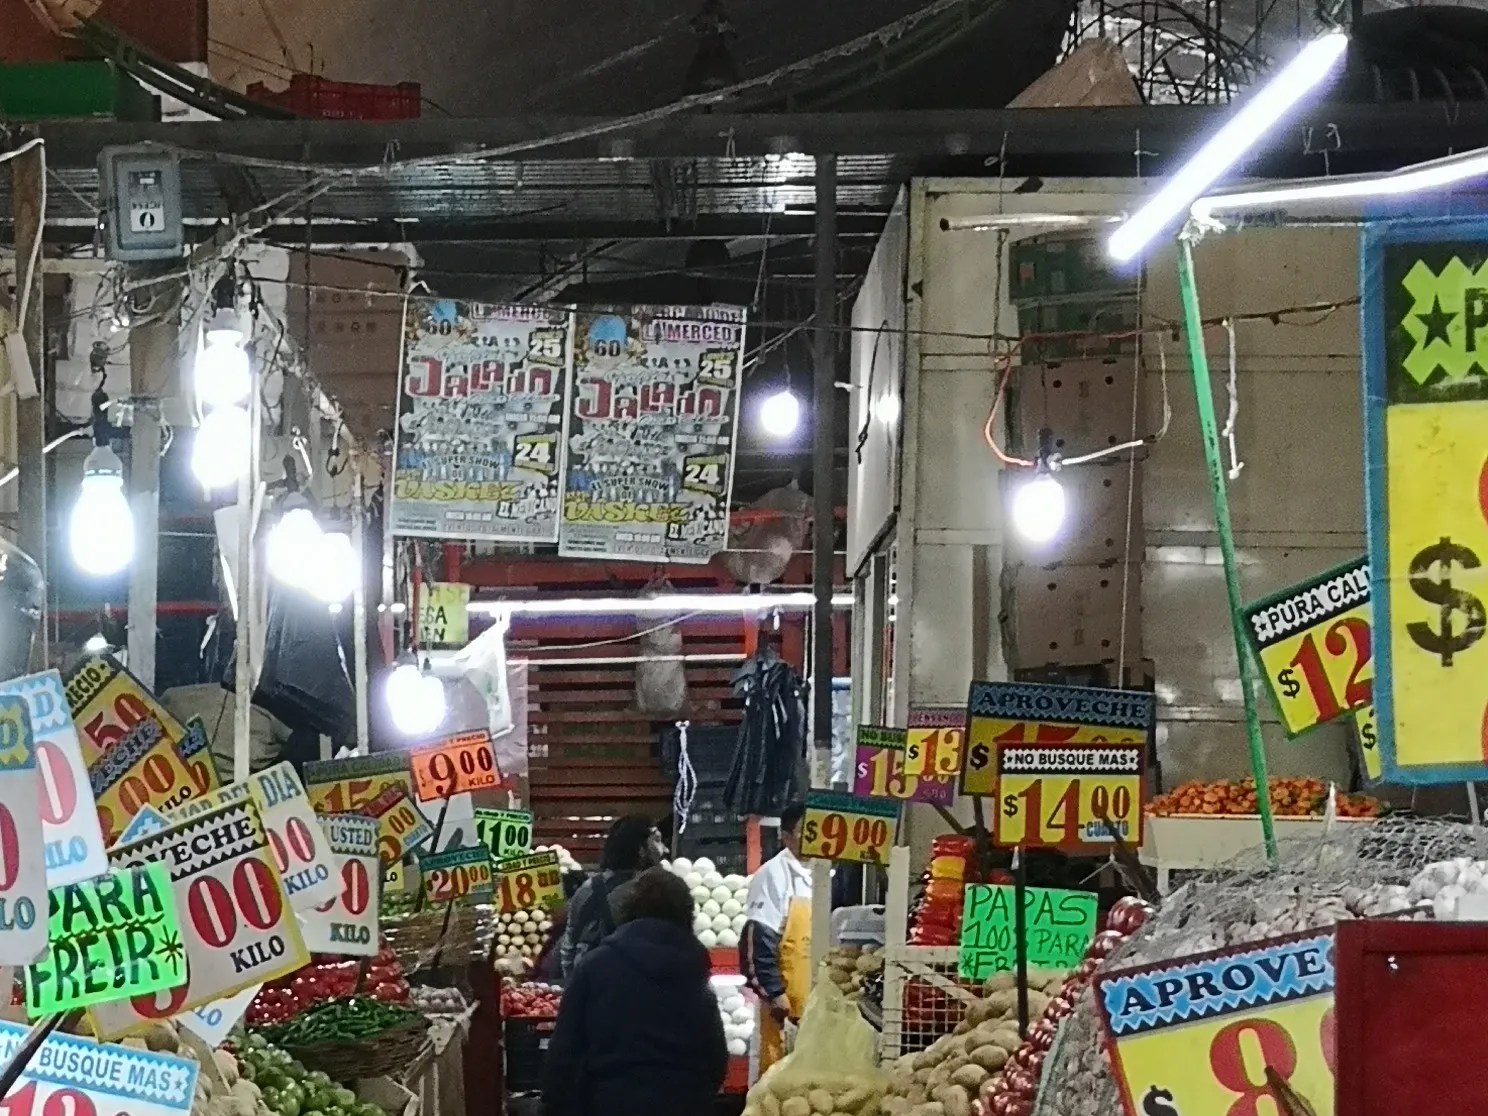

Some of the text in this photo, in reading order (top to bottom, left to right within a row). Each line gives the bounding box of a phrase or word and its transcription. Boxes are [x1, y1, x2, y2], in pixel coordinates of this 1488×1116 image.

[528, 338, 561, 357] 25
[594, 339, 621, 357] 60
[698, 360, 733, 379] 25
[435, 455, 466, 466] SUPER
[468, 456, 501, 469] SHOW
[515, 442, 551, 463] 24
[604, 476, 636, 488] SUPER
[638, 477, 670, 490] SHOW
[684, 464, 720, 484] 24
[1267, 594, 1324, 629] PURA
[978, 691, 1146, 719] APROVECHE
[459, 746, 494, 776] 00
[1014, 753, 1128, 766] NO BUSQUE MAS
[119, 754, 176, 817] 00
[259, 766, 302, 808] DIA
[468, 774, 496, 787] KILO
[1091, 785, 1131, 819] 00
[389, 806, 416, 835] 00
[853, 816, 888, 848] 00
[1086, 820, 1129, 837] CUATO
[330, 825, 373, 847] USTED
[505, 825, 529, 848] 00
[284, 863, 330, 895] KILO
[470, 864, 489, 883] 00
[188, 857, 283, 948] 00
[967, 884, 1097, 926] PAPAS
[329, 923, 371, 945] KILO
[1032, 928, 1091, 958] PARA
[230, 935, 286, 974] KILO
[1120, 948, 1325, 1017] APROVE
[39, 1046, 172, 1092] BUSQUE MAS
